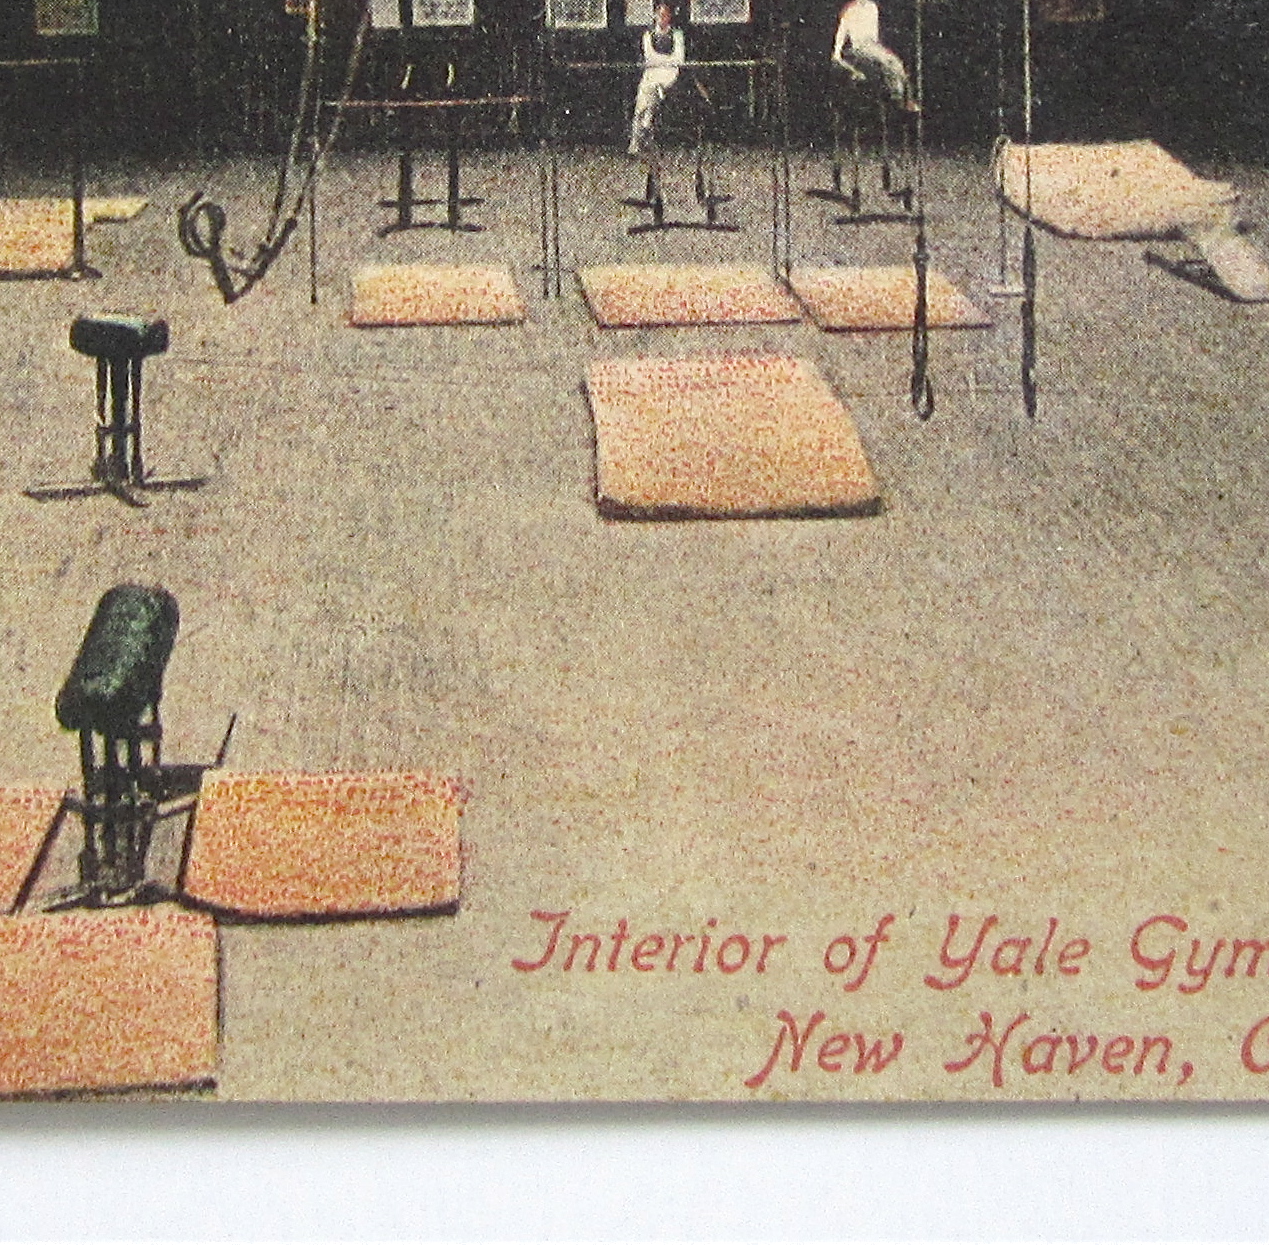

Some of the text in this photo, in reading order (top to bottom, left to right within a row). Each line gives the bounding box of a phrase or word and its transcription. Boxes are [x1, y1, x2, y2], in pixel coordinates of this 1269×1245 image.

[511, 911, 786, 974] Interior
[823, 914, 896, 992] of
[924, 915, 1090, 990] Yale
[745, 1010, 904, 1088] New
[945, 1011, 1196, 1088] Haven,
